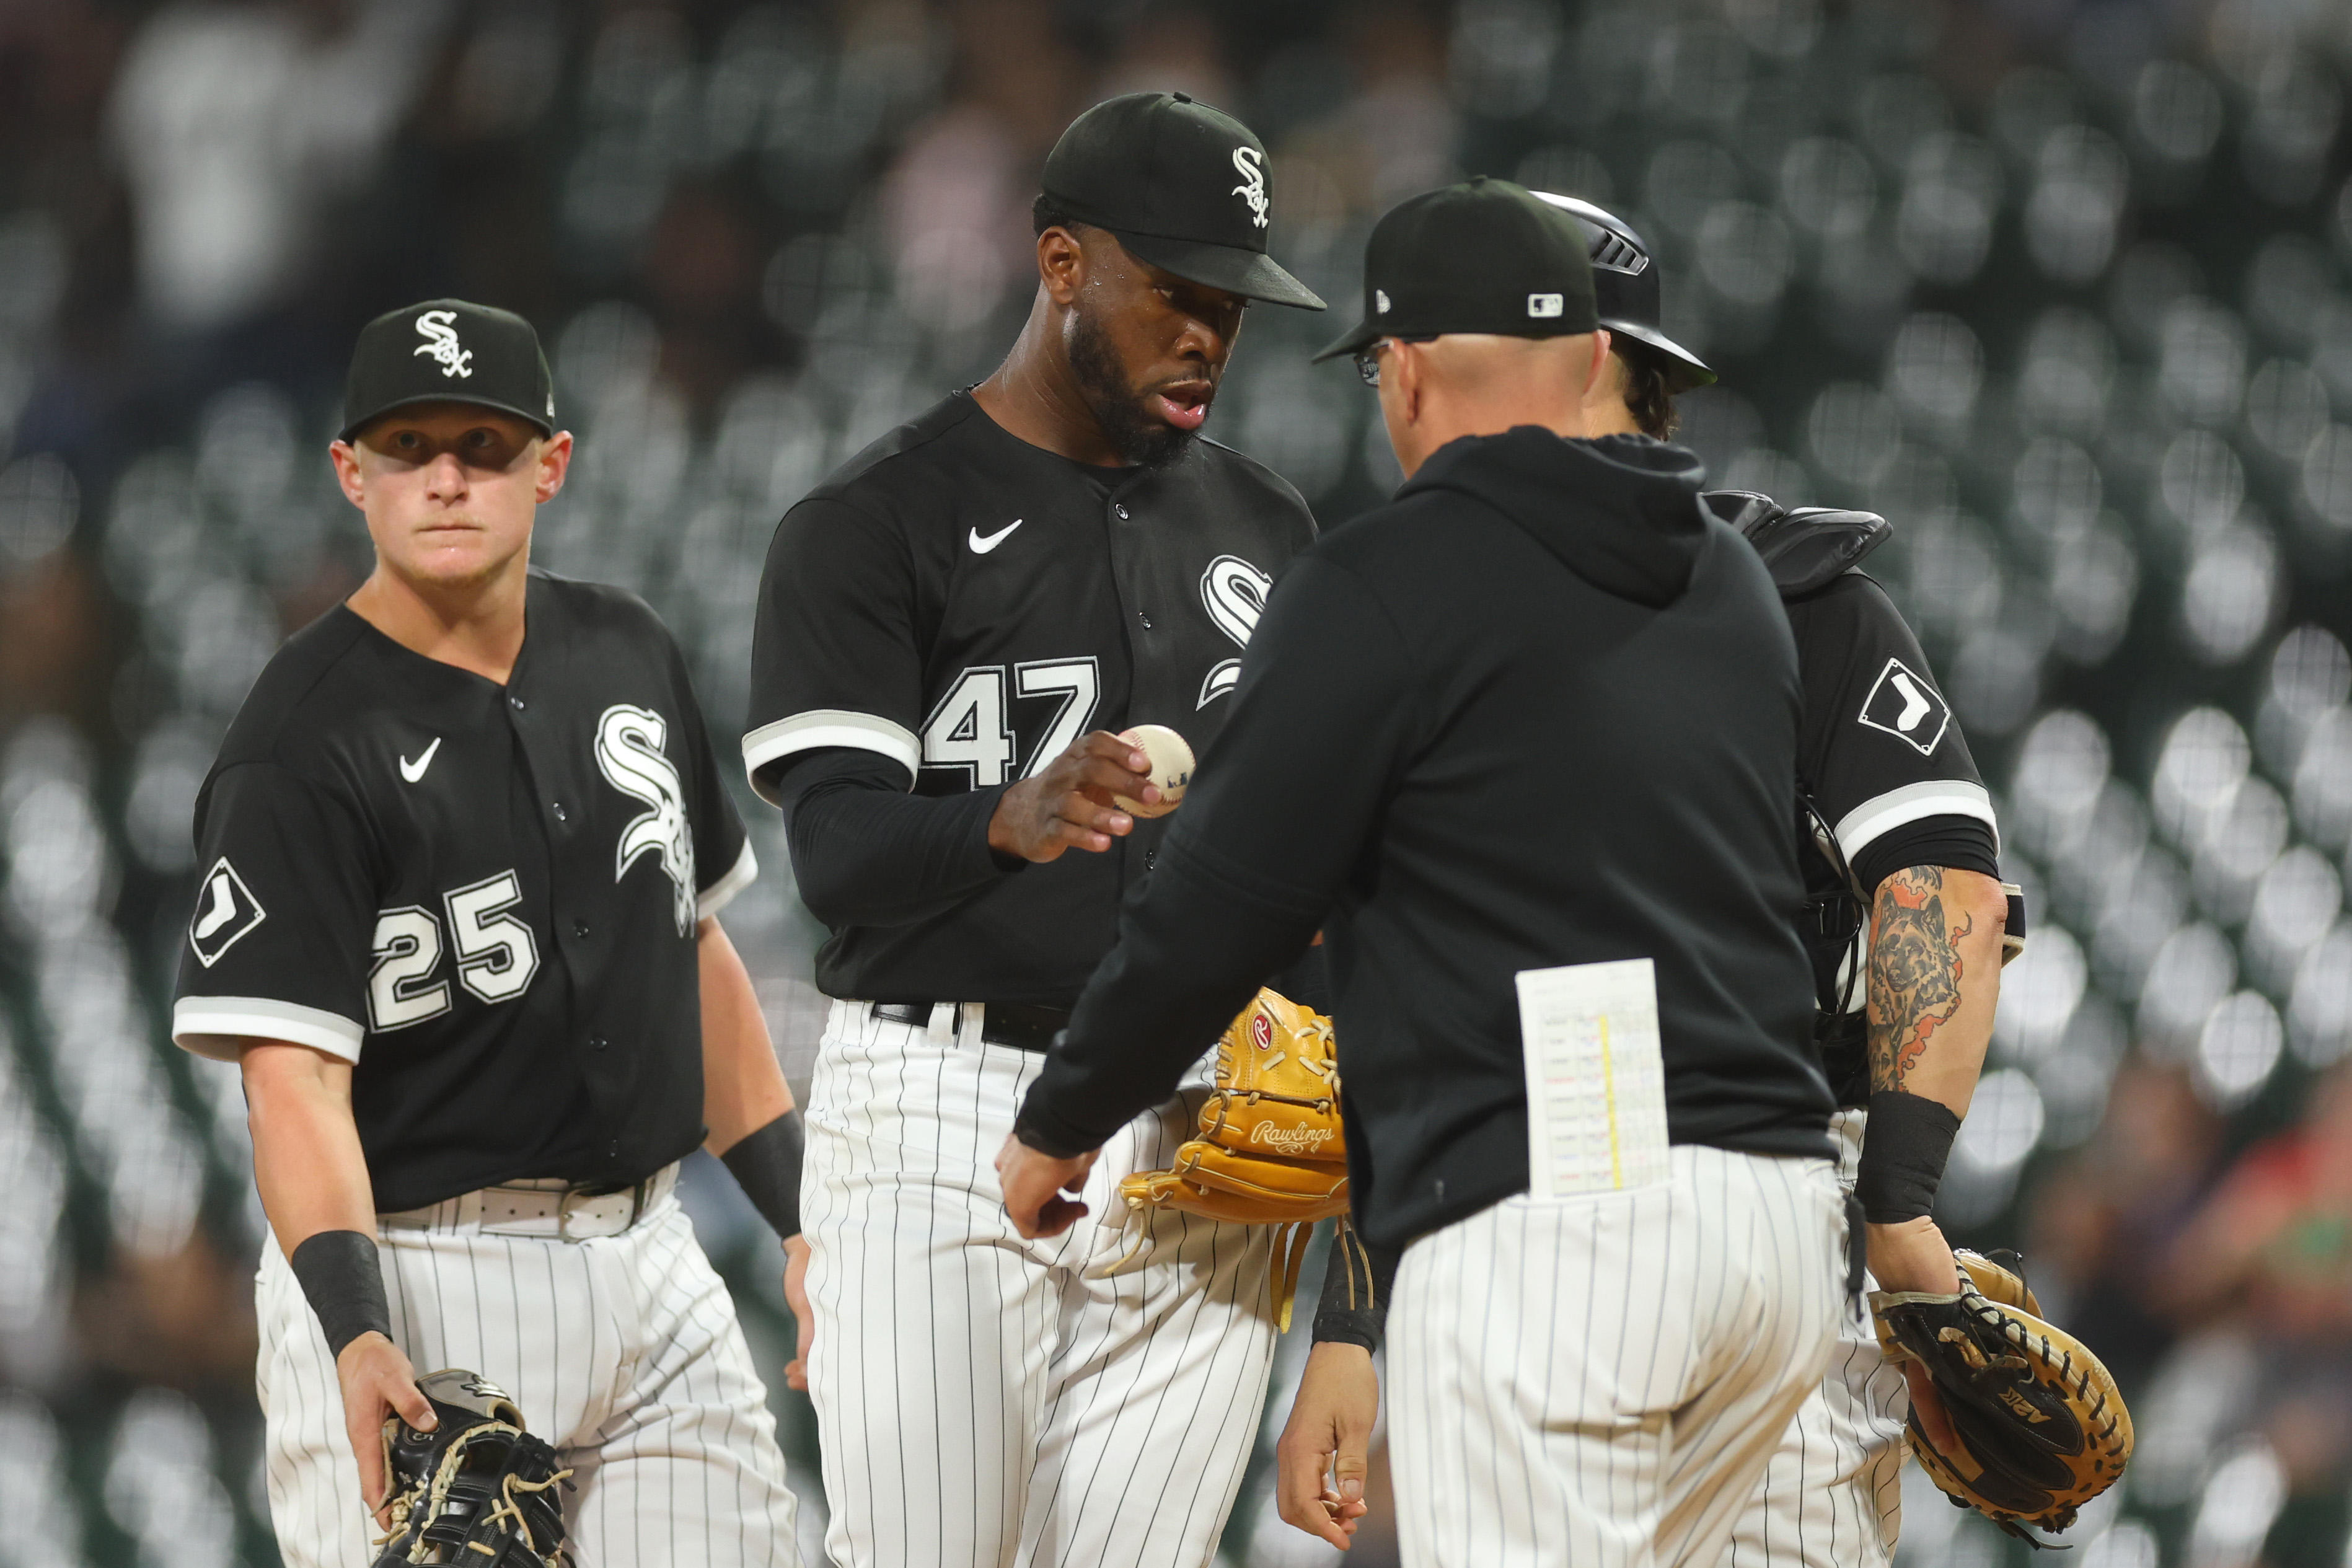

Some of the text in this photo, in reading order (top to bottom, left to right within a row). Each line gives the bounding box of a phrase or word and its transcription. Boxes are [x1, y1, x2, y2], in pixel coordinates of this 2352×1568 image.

[918, 655, 1101, 792] 47
[367, 868, 540, 1034] 25
[1251, 1119, 1334, 1155] Rawlings
[1997, 1386, 2051, 1424] A2K
